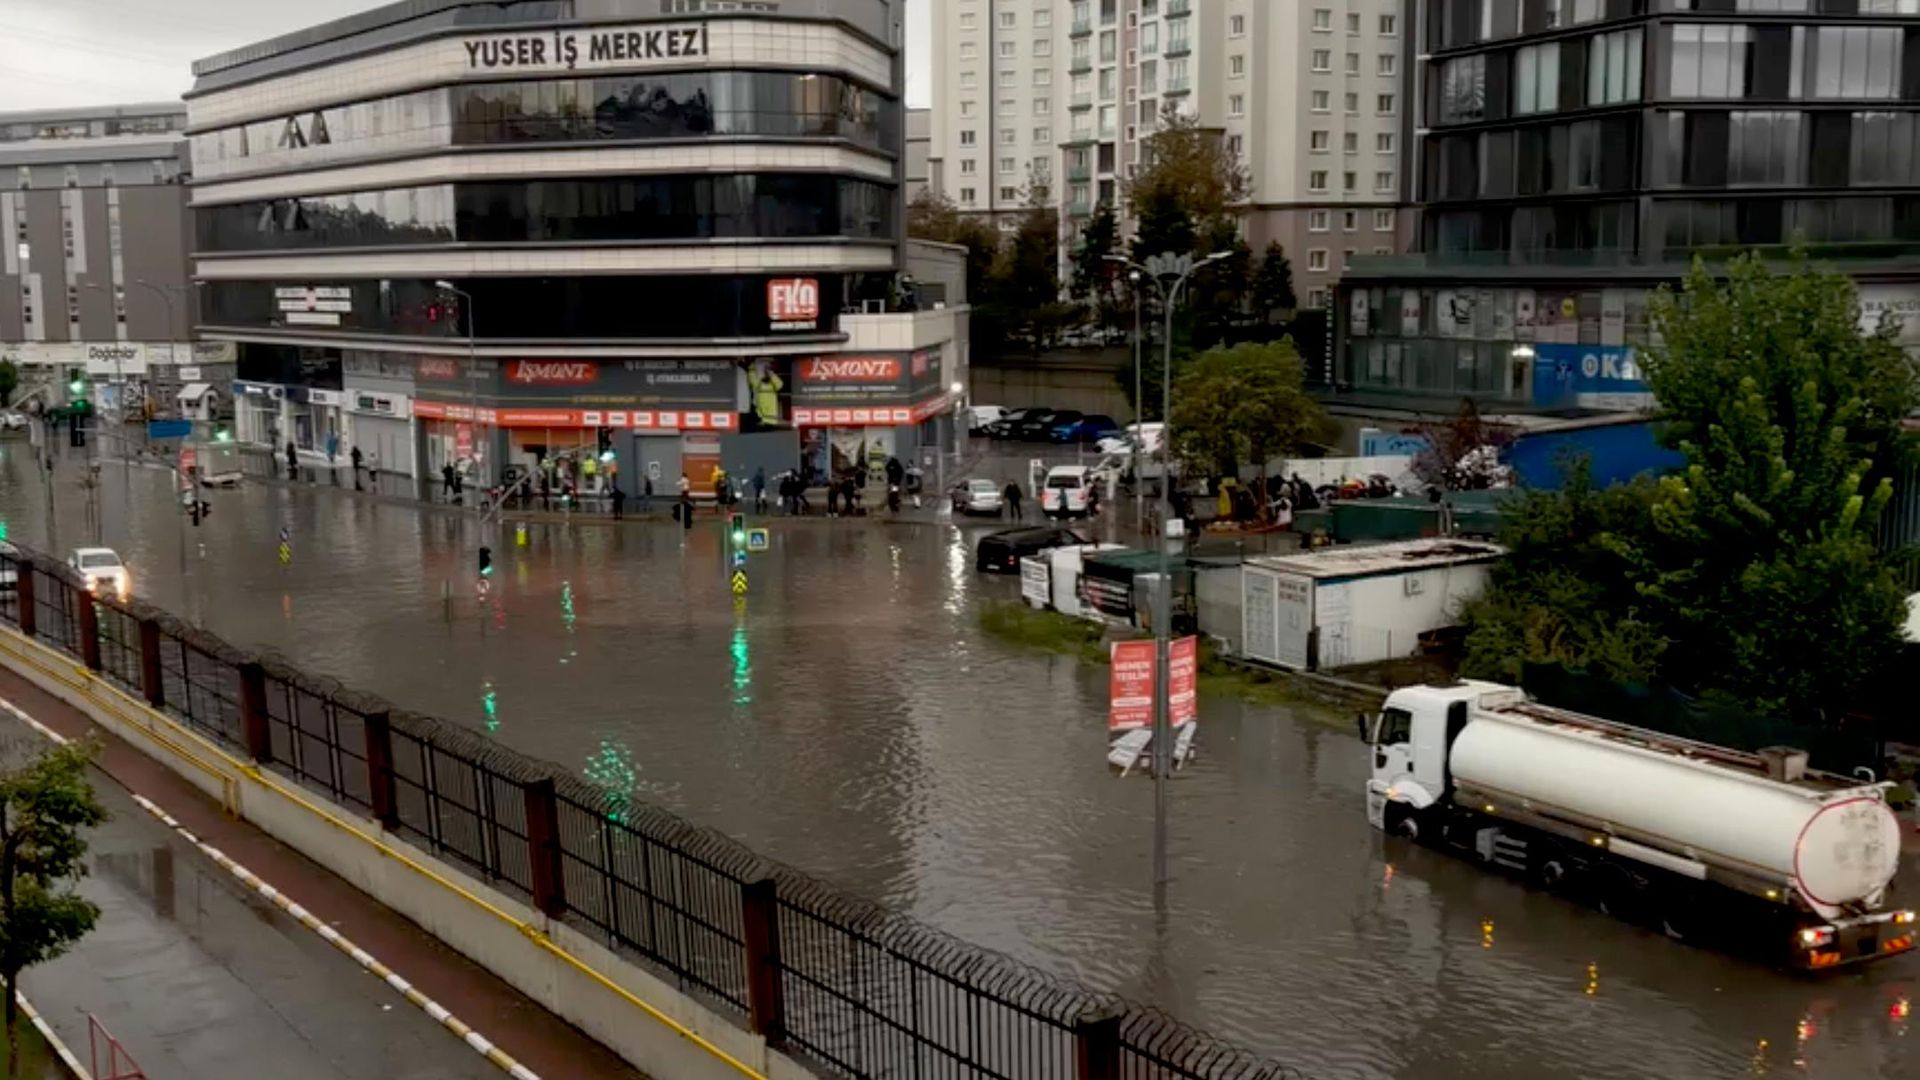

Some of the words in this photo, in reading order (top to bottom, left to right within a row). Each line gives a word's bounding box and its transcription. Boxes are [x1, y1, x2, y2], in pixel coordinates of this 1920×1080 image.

[464, 37, 546, 68] YUSER
[555, 29, 579, 69] İŞ
[589, 22, 709, 61] MERKEZİ
